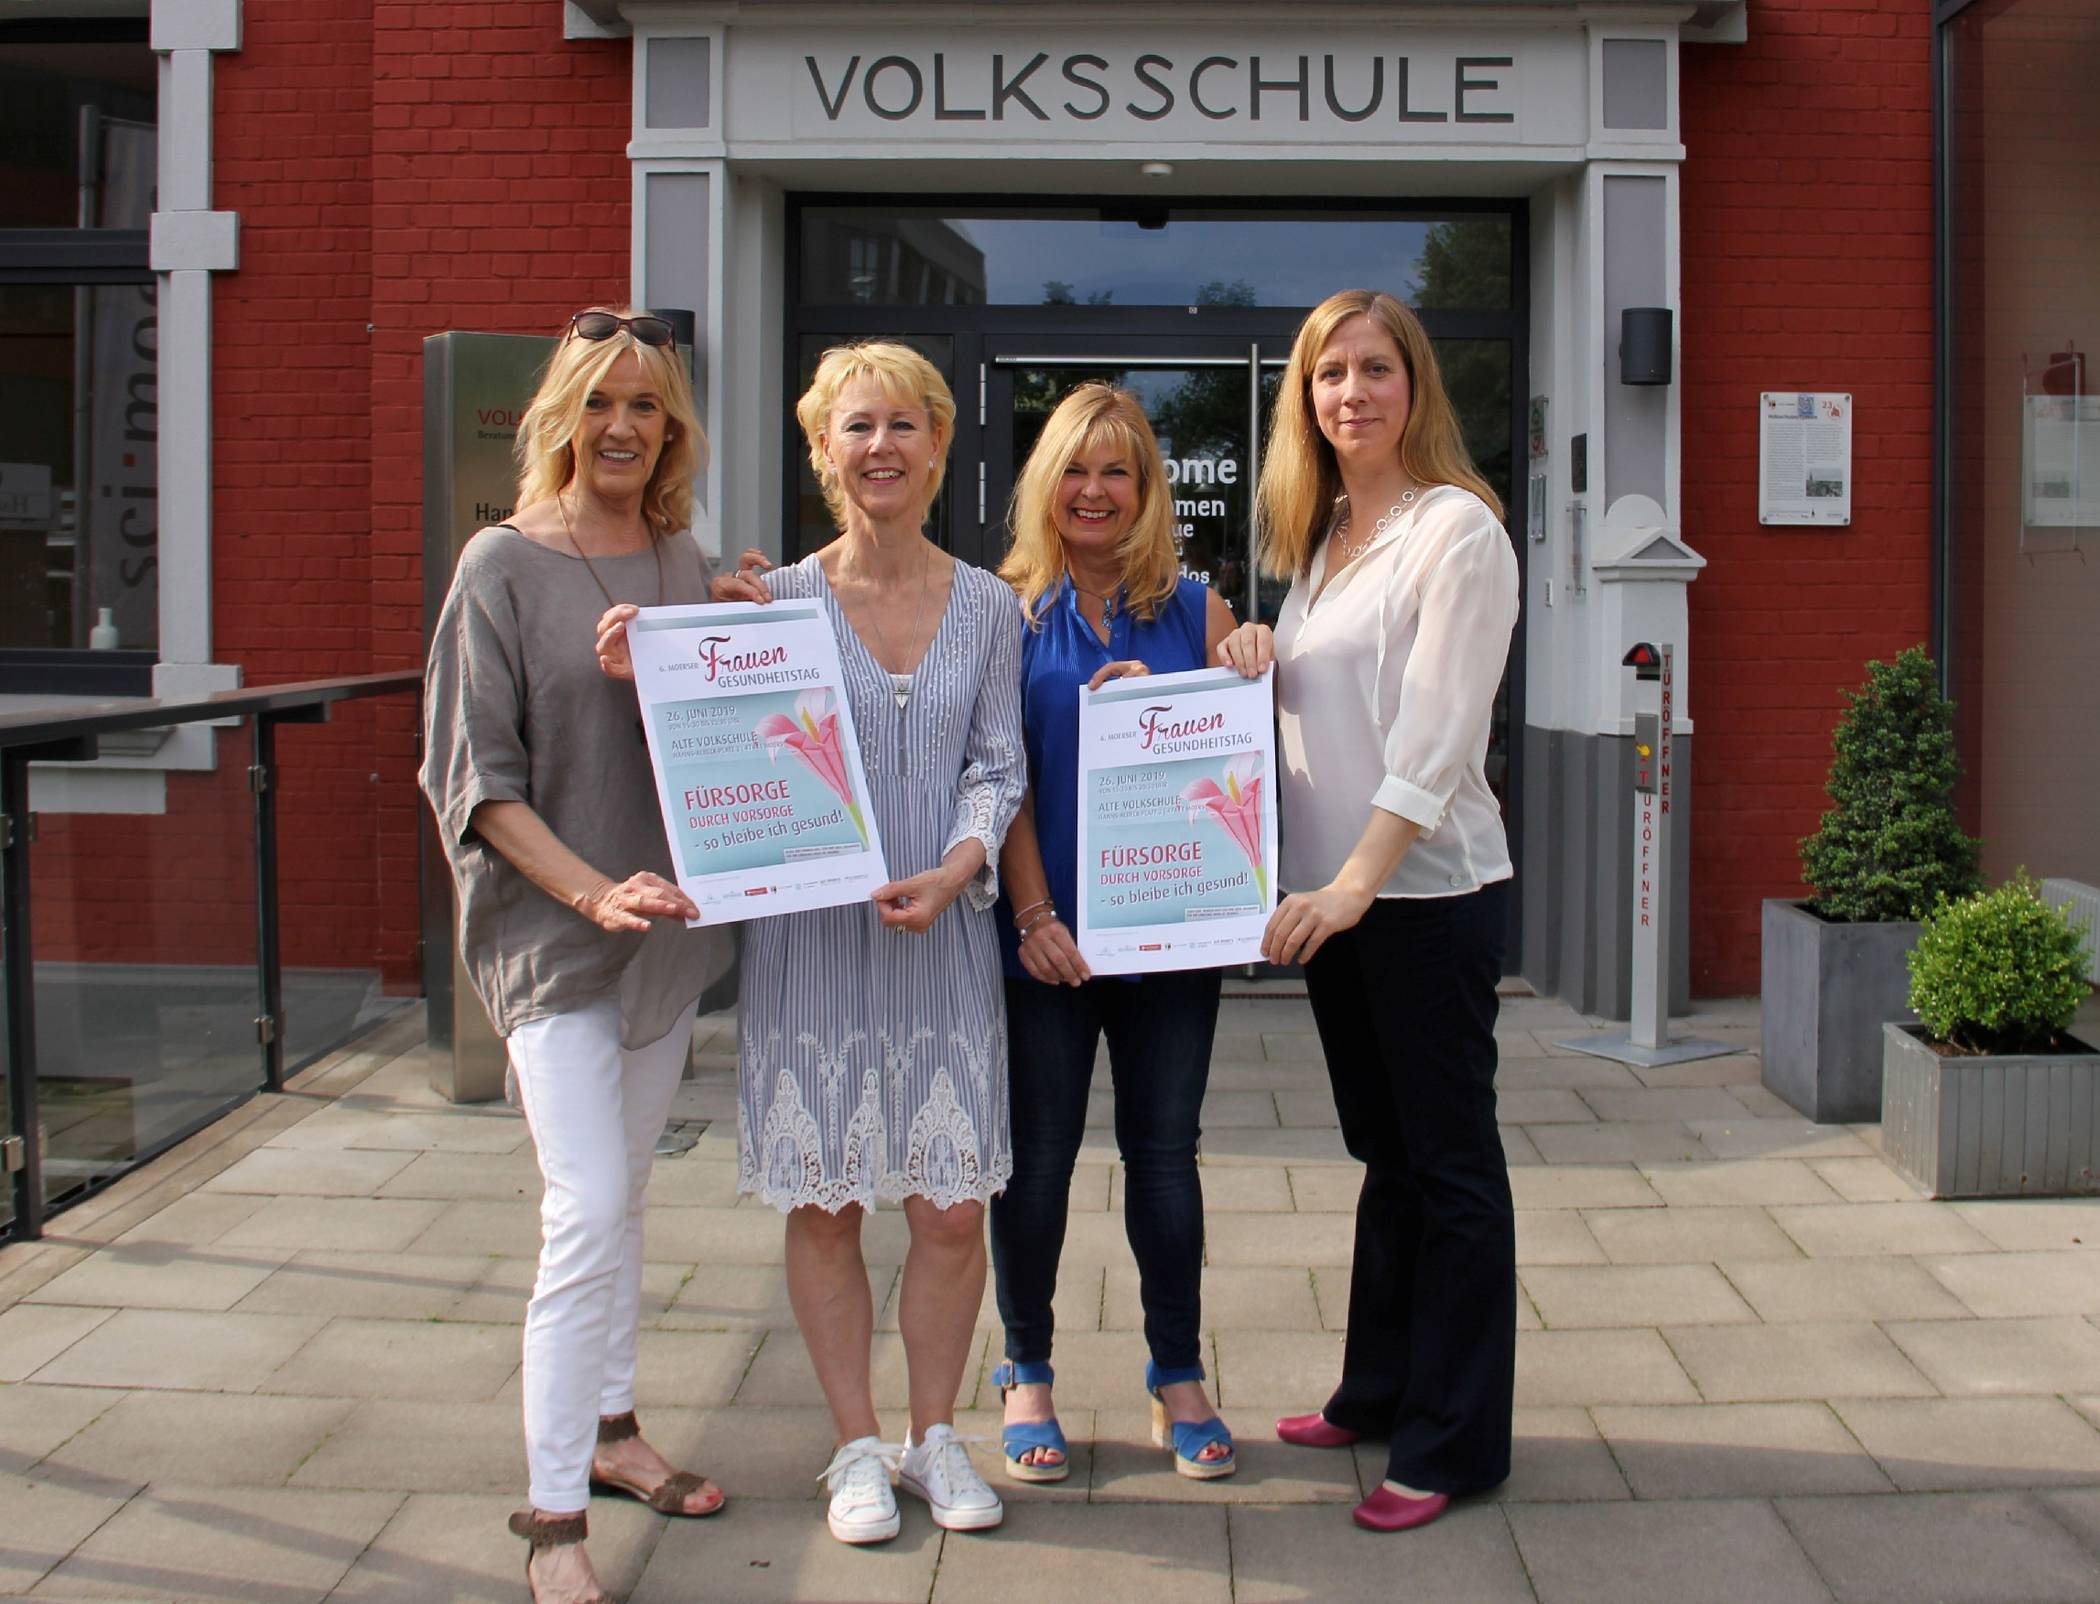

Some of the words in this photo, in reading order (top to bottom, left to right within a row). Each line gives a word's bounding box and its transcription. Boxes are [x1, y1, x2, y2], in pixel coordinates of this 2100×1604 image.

[804, 52, 1515, 123] VOLKSSCHULE
[1163, 457, 1237, 484] ome
[476, 503, 514, 521] Han
[1174, 500, 1225, 516] men
[1178, 565, 1210, 584] dos
[698, 635, 788, 682] Frauen
[717, 668, 820, 688] GESUNDHEITSTAG
[666, 711, 684, 722] 26.
[686, 707, 709, 721] JUNI
[711, 705, 736, 718] 2019
[1139, 704, 1225, 750] Frauen
[1661, 654, 1671, 814] TÜRÖFFNER
[671, 737, 695, 751] ALTE
[1152, 732, 1252, 755] GESUNDHEITSTAG
[1099, 776, 1115, 786] 26.
[1116, 774, 1138, 787] JUNI
[1140, 771, 1166, 781] 2019
[684, 779, 791, 811] FÜRSORGE
[1099, 801, 1120, 812] ALTE
[689, 813, 729, 829] DURCH
[733, 805, 794, 824] VORSORGE
[704, 838, 719, 850] so
[722, 827, 765, 847] bleibe
[768, 821, 788, 837] ich
[792, 809, 844, 835] gesund!
[1100, 841, 1202, 868] FÜRSORGE
[1100, 871, 1139, 885] DURCH
[1143, 866, 1203, 882] VORSORGE
[1110, 895, 1124, 906] so
[1129, 889, 1170, 904] bleibe
[1174, 882, 1193, 897] ich
[1197, 872, 1249, 896] gesund!
